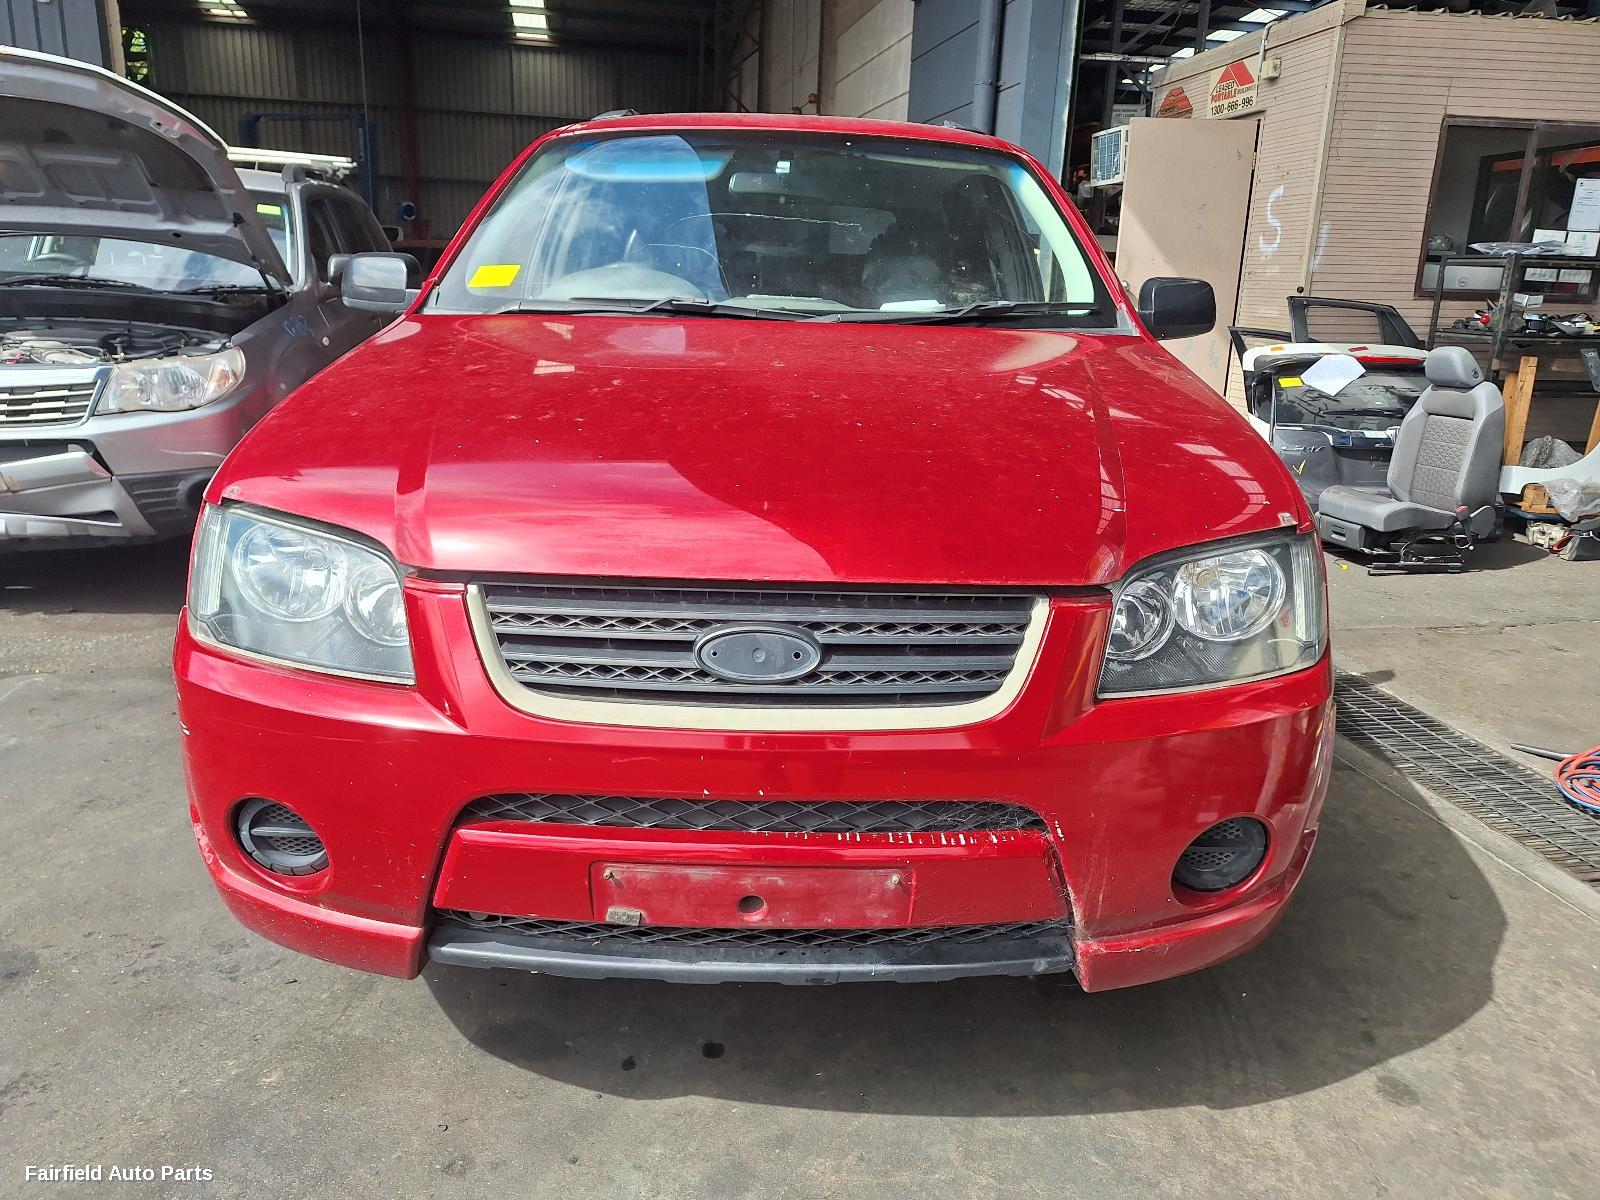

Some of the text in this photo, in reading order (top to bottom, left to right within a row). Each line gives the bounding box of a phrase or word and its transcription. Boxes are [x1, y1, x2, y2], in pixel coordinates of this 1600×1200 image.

[1215, 80, 1235, 93] LEASED
[1211, 88, 1238, 104] PORTABLE
[1211, 95, 1254, 116] 1300-666-996
